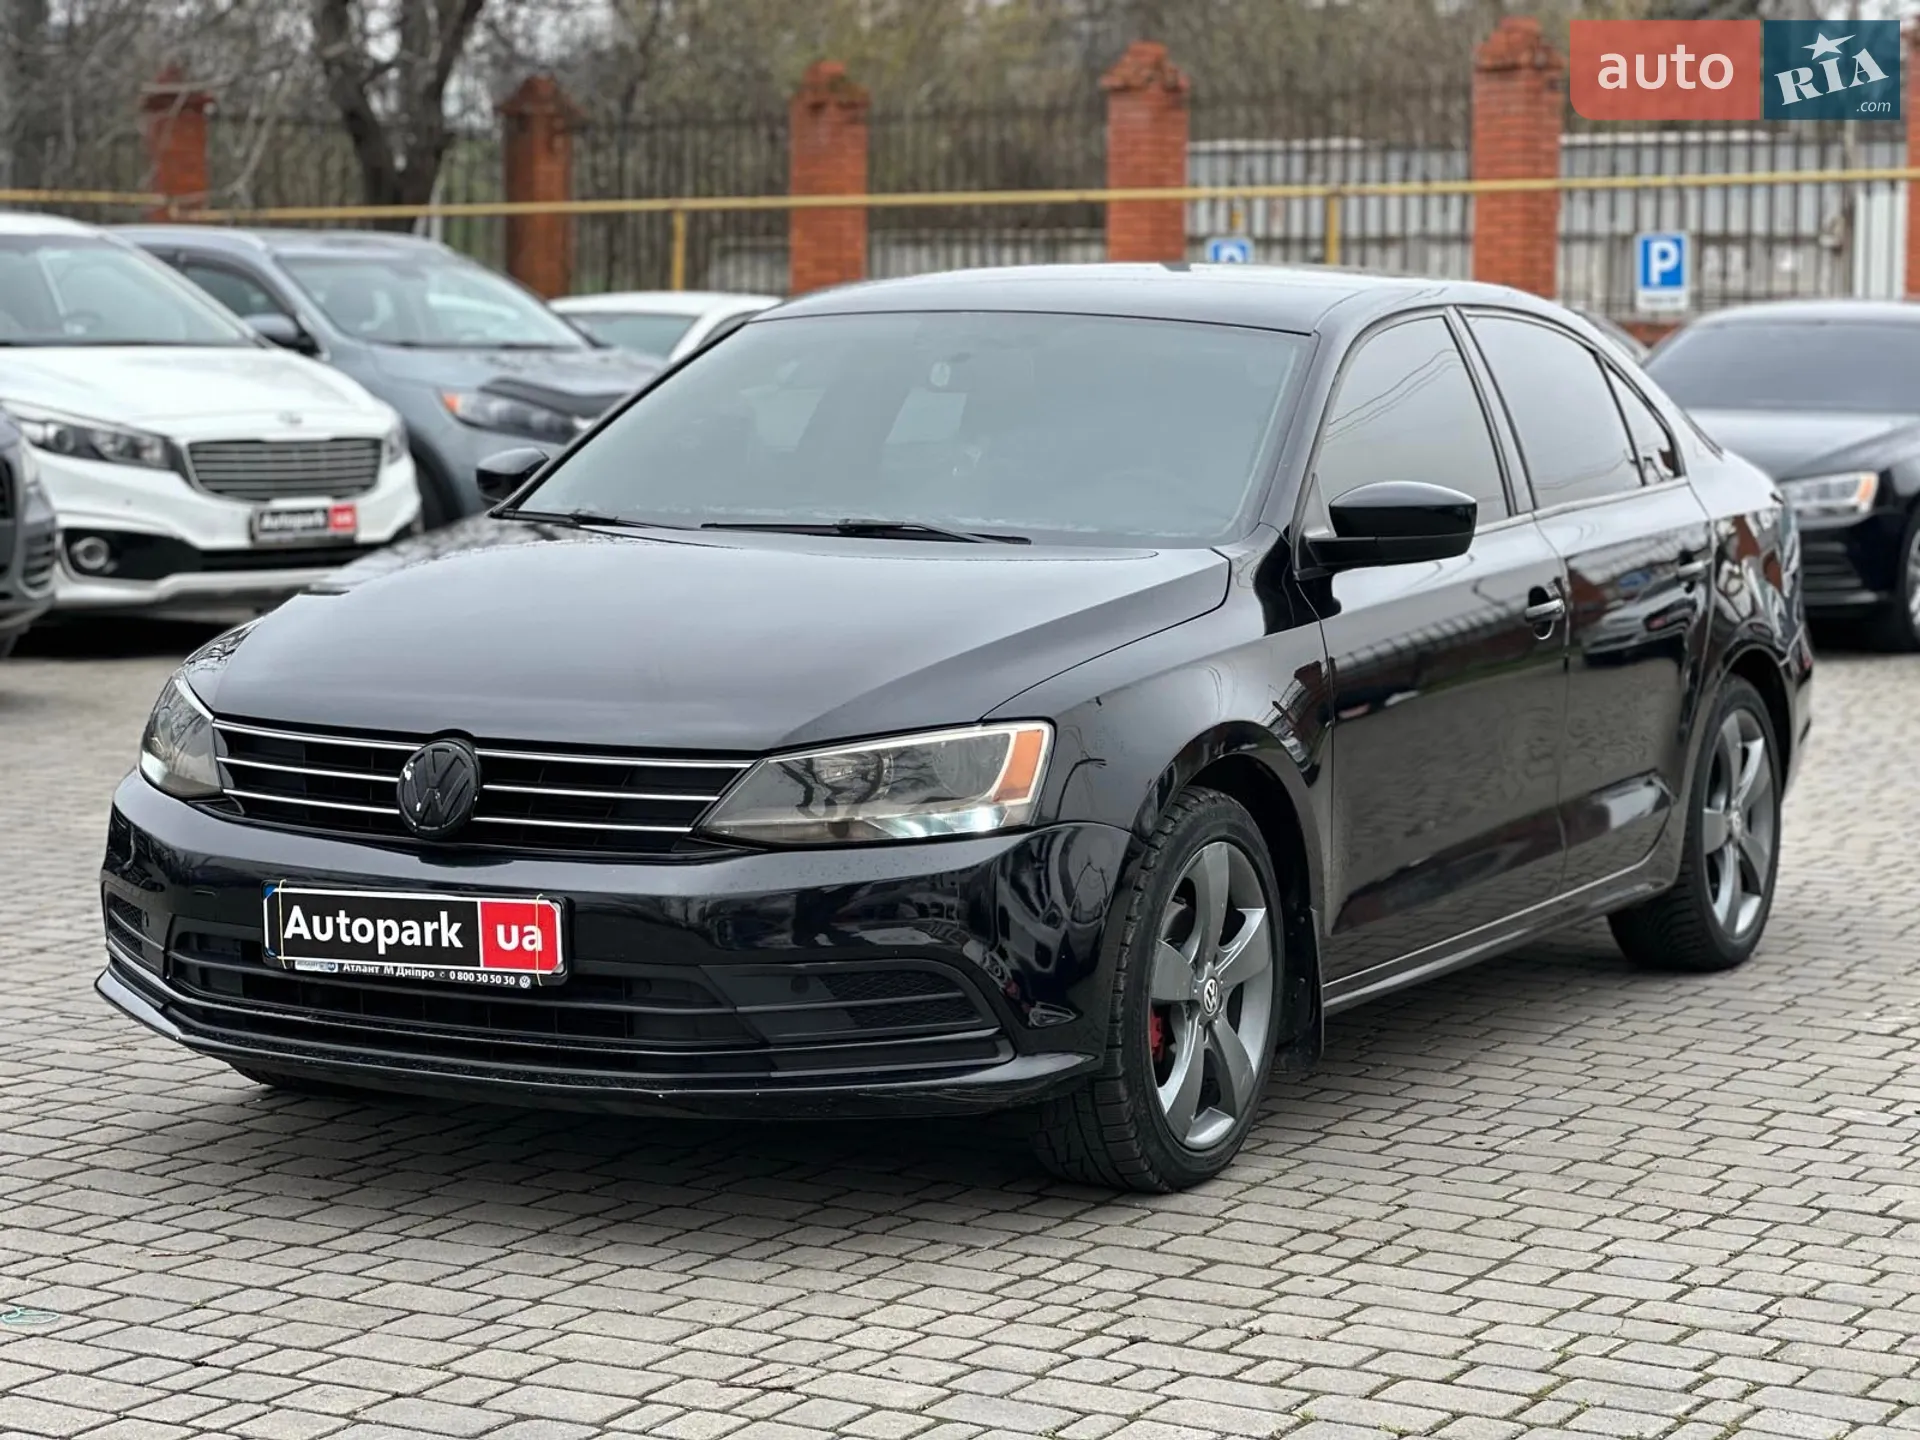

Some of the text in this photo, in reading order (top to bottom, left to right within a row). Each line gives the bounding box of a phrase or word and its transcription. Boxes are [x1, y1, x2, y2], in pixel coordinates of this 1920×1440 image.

[1649, 239, 1679, 285] P
[260, 510, 326, 530] Autopark
[283, 904, 543, 956] Autopark ua
[342, 962, 380, 975] Атлант
[395, 966, 435, 980] Дніпро
[449, 970, 456, 980] 0
[457, 971, 475, 981] 800
[476, 972, 489, 983] 30
[490, 973, 502, 984] 50
[503, 975, 516, 985] 30
